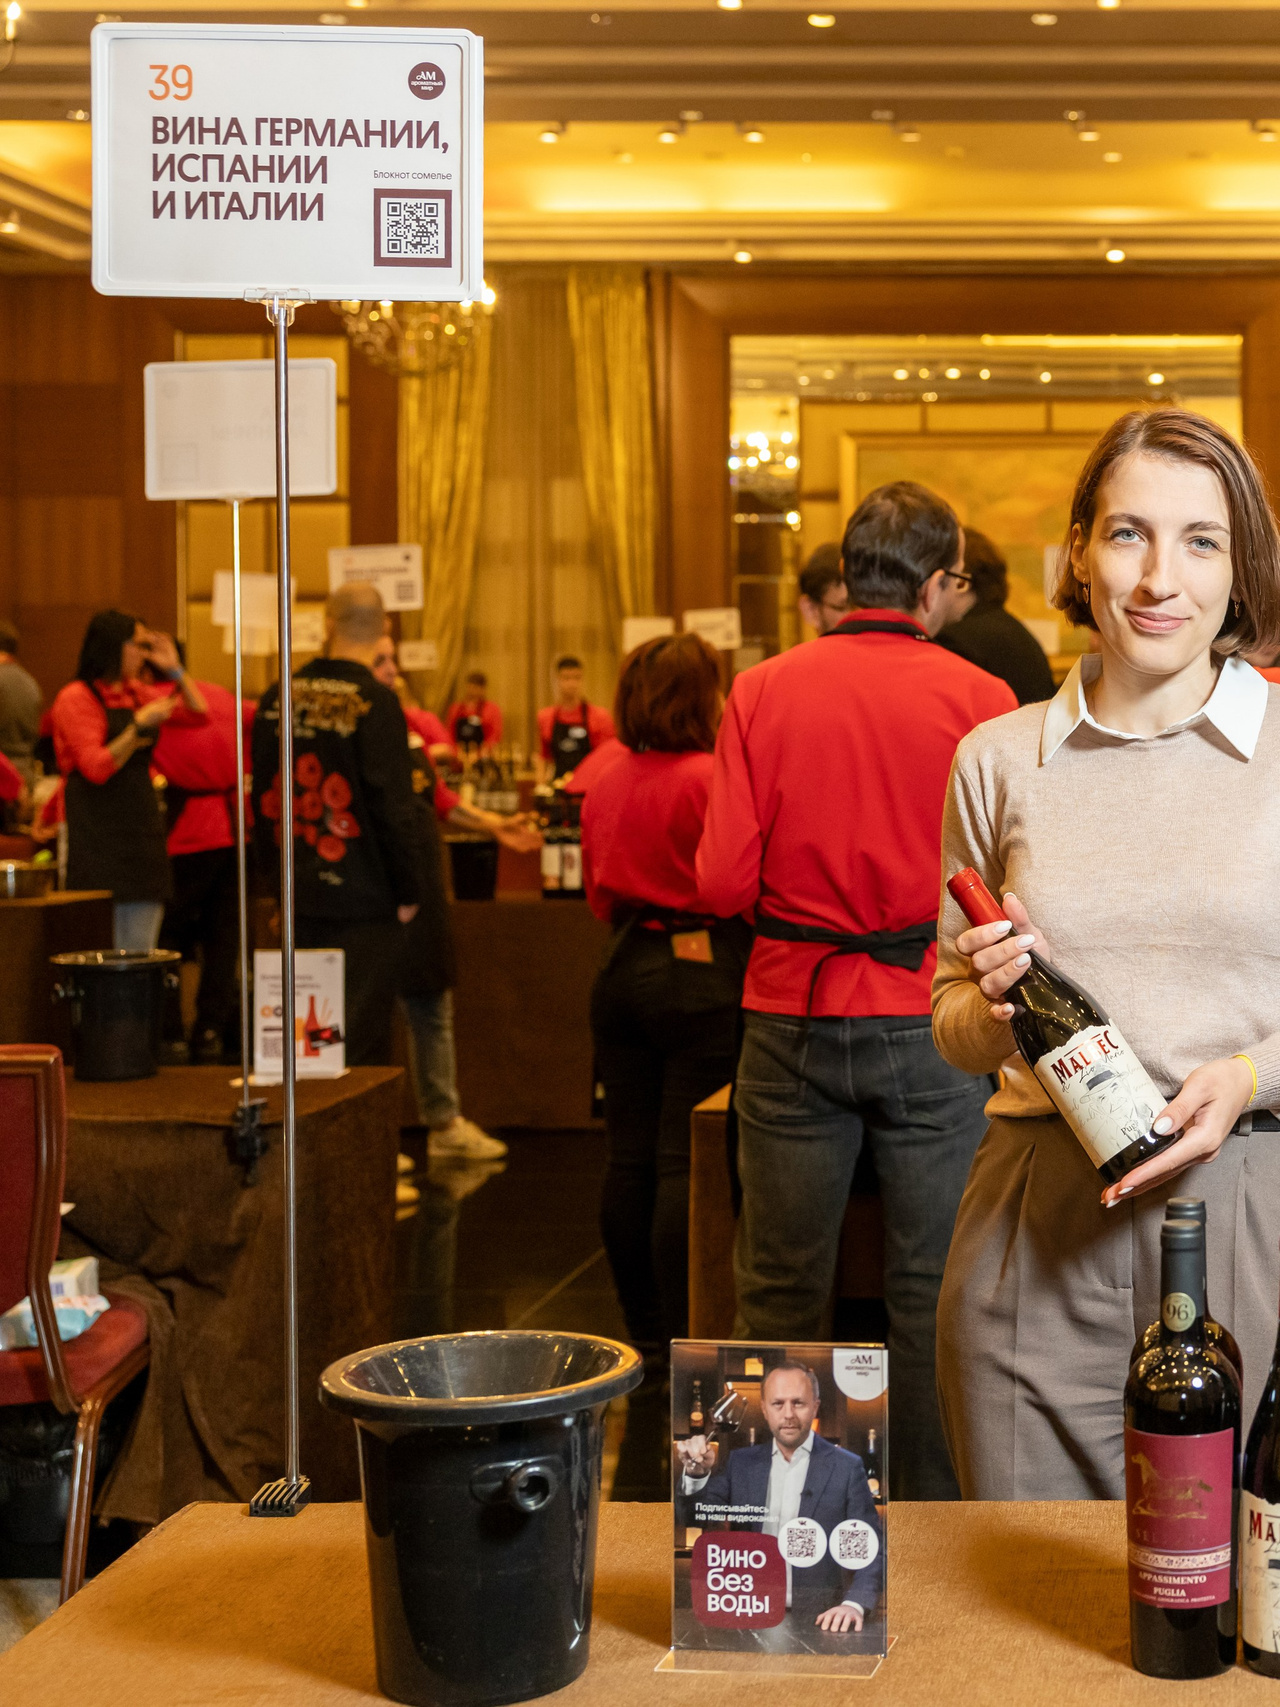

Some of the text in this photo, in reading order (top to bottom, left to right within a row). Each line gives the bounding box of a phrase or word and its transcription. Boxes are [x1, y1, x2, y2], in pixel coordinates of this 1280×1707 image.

[148, 64, 194, 101] 39
[152, 116, 449, 154] ВИНА ГЕРМАНИИ,
[152, 153, 328, 184] ИСПАНИИ
[373, 169, 453, 181] Блокнот сомелье
[152, 190, 324, 222] И ИТАЛИИ
[1050, 1029, 1119, 1085] MALEC
[1166, 1303, 1189, 1321] 96
[695, 1502, 770, 1514] Подписывайтесь
[695, 1513, 707, 1521] на
[708, 1513, 726, 1522] наш
[707, 1543, 767, 1569] Вино
[706, 1567, 754, 1592] без
[1139, 1570, 1207, 1585] APPASSIMENTO
[1153, 1586, 1187, 1598] PUGLIA
[707, 1594, 770, 1617] воды
